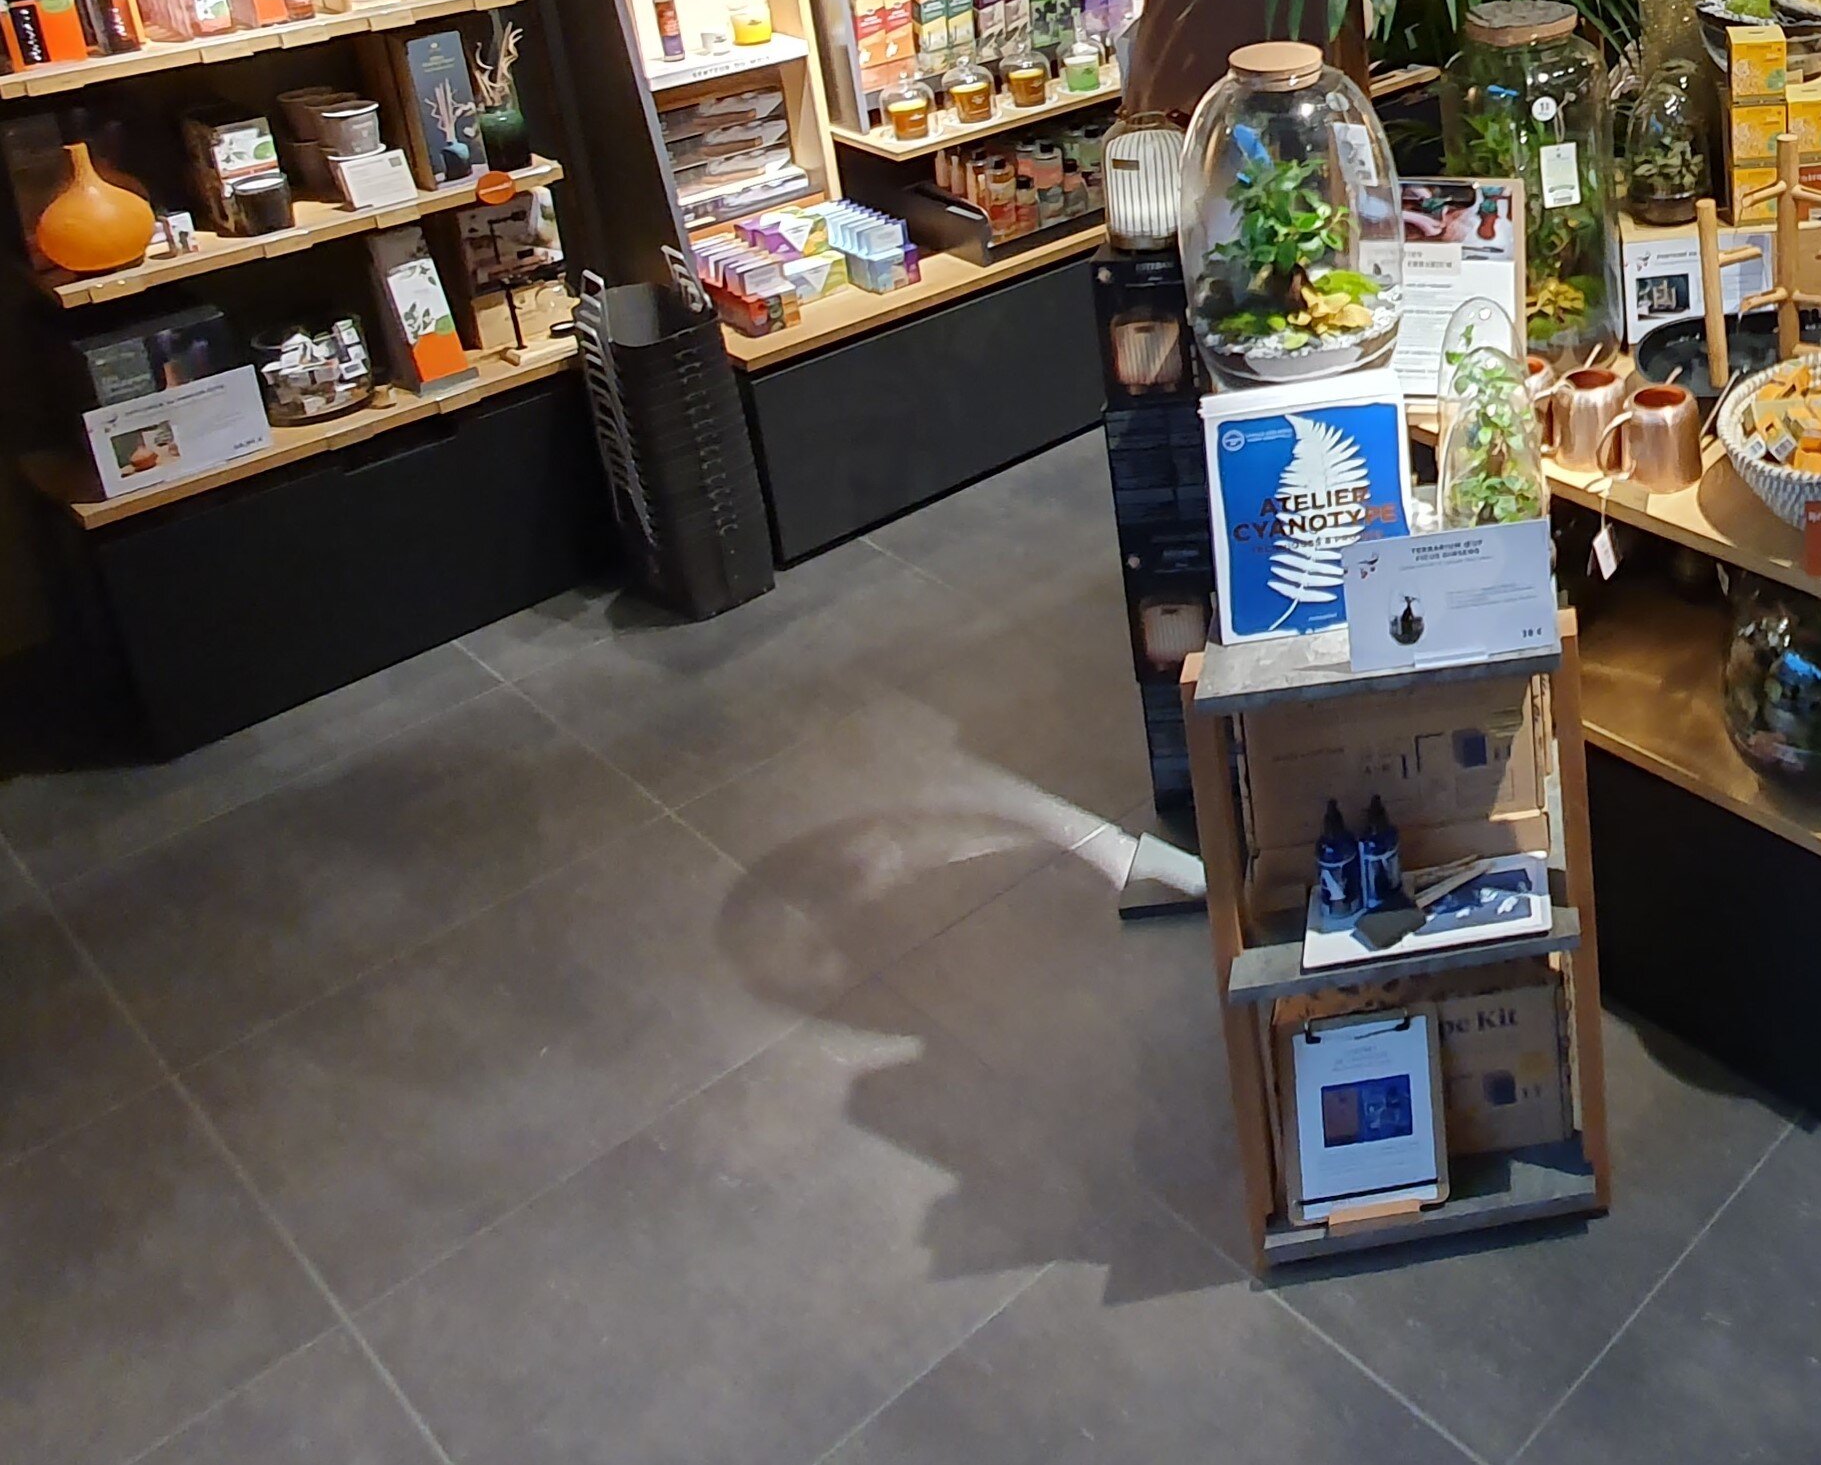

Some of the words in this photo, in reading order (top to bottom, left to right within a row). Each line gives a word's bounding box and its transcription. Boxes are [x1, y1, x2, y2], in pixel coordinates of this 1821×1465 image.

[1260, 486, 1369, 517] ATELIER
[1232, 503, 1397, 542] CYANOTYPE
[1477, 1007, 1518, 1033] Kit
